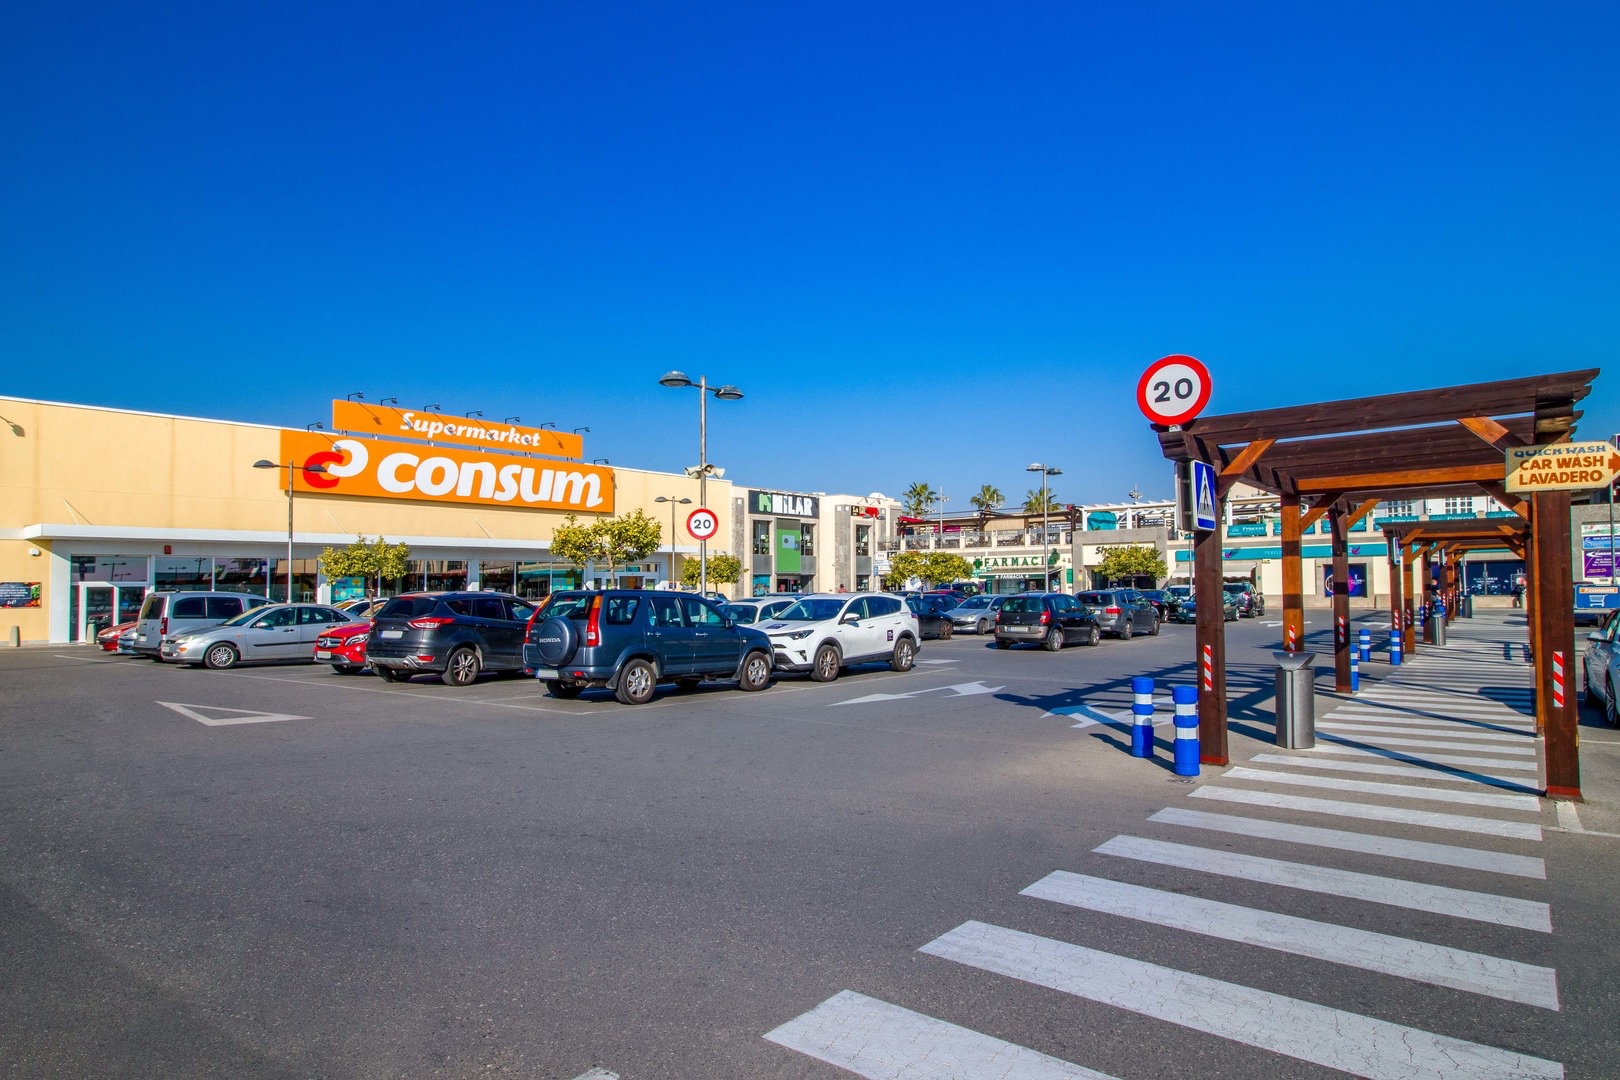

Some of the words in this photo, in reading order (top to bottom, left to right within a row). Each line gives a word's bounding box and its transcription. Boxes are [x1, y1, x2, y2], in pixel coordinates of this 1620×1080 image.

[1153, 377, 1193, 403] 20
[400, 412, 541, 447] Supermarket
[1520, 459, 1552, 471] CAR
[1556, 455, 1604, 469] WASH
[376, 452, 603, 508] consum
[1519, 470, 1603, 485] LAVADERO
[693, 519, 712, 529] 20
